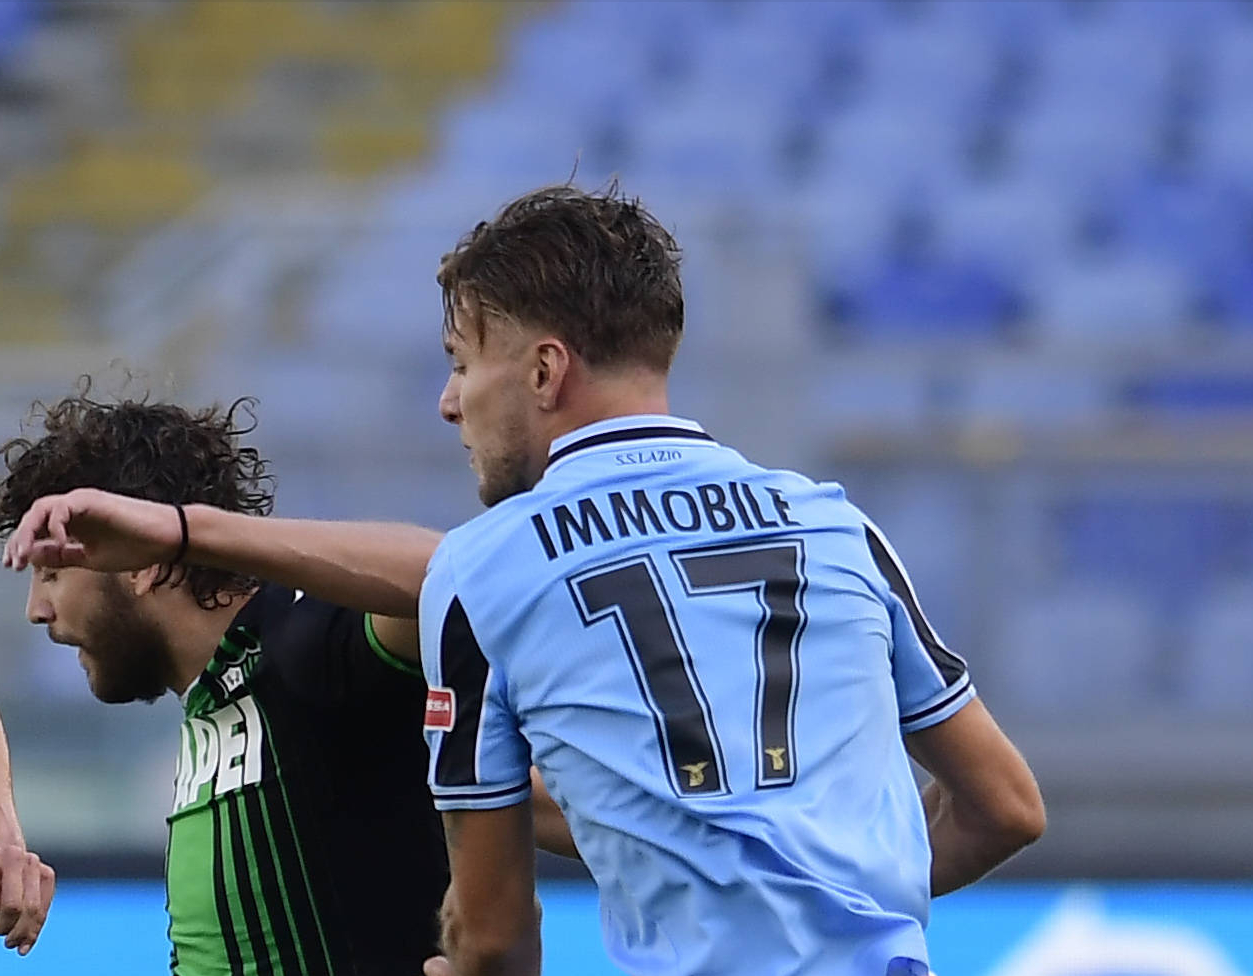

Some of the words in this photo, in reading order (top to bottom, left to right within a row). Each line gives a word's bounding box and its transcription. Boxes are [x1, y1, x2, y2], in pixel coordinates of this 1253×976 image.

[531, 481, 802, 562] IMMOBILE
[565, 538, 809, 799] 17
[173, 695, 263, 814] APEI
